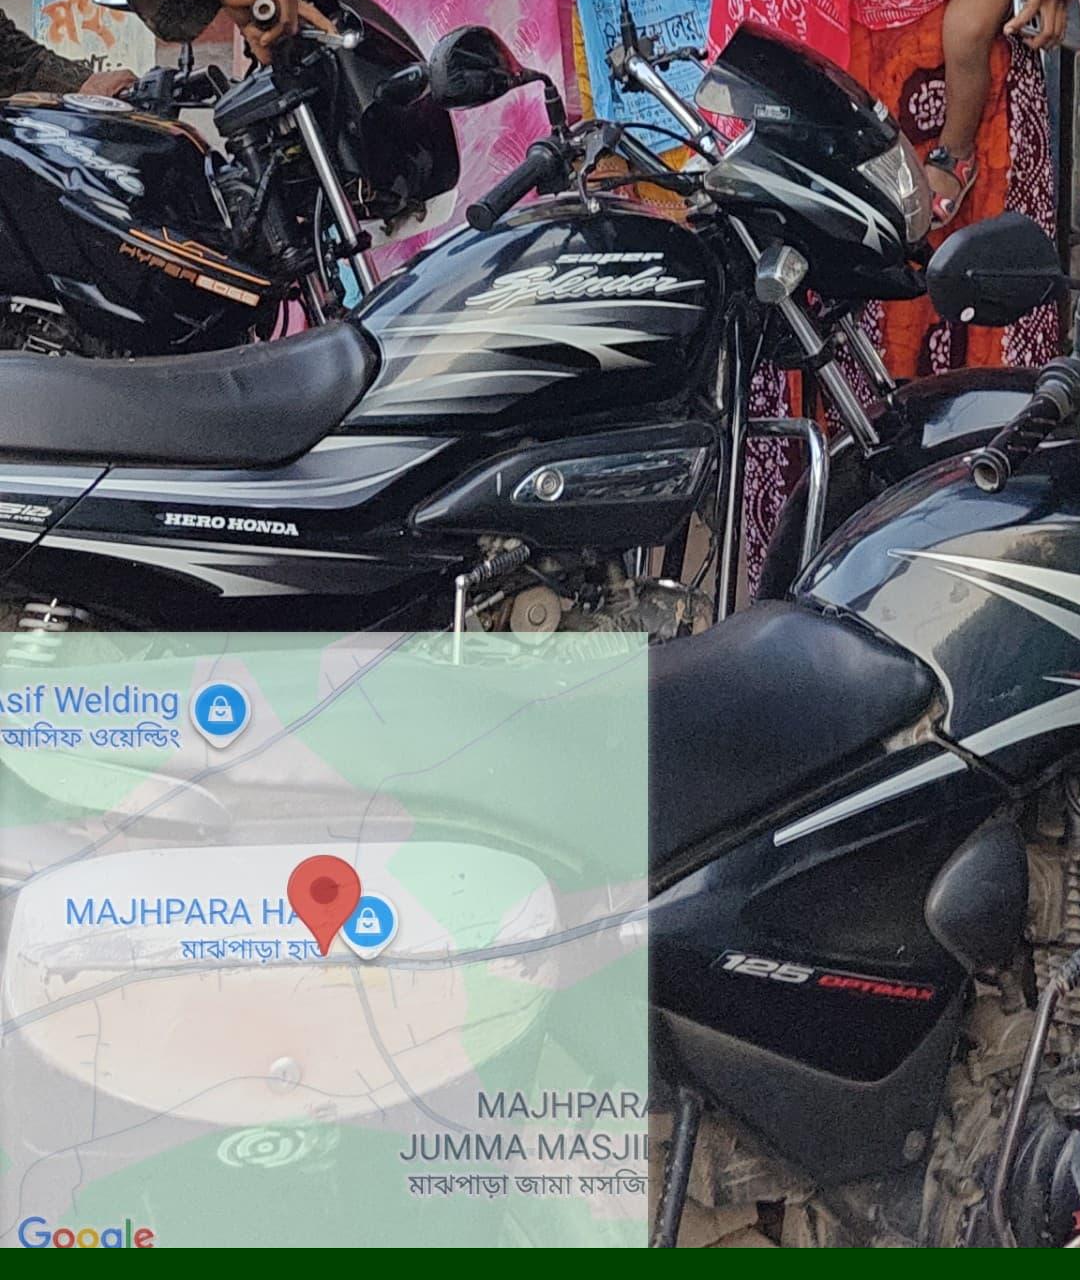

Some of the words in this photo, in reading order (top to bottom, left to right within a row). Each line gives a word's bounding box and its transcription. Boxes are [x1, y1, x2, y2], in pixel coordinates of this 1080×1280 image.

[555, 251, 665, 265] super
[465, 265, 706, 314] Splendor
[164, 511, 226, 531] HERO
[226, 517, 300, 537] HONDA
[721, 949, 812, 985] 125
